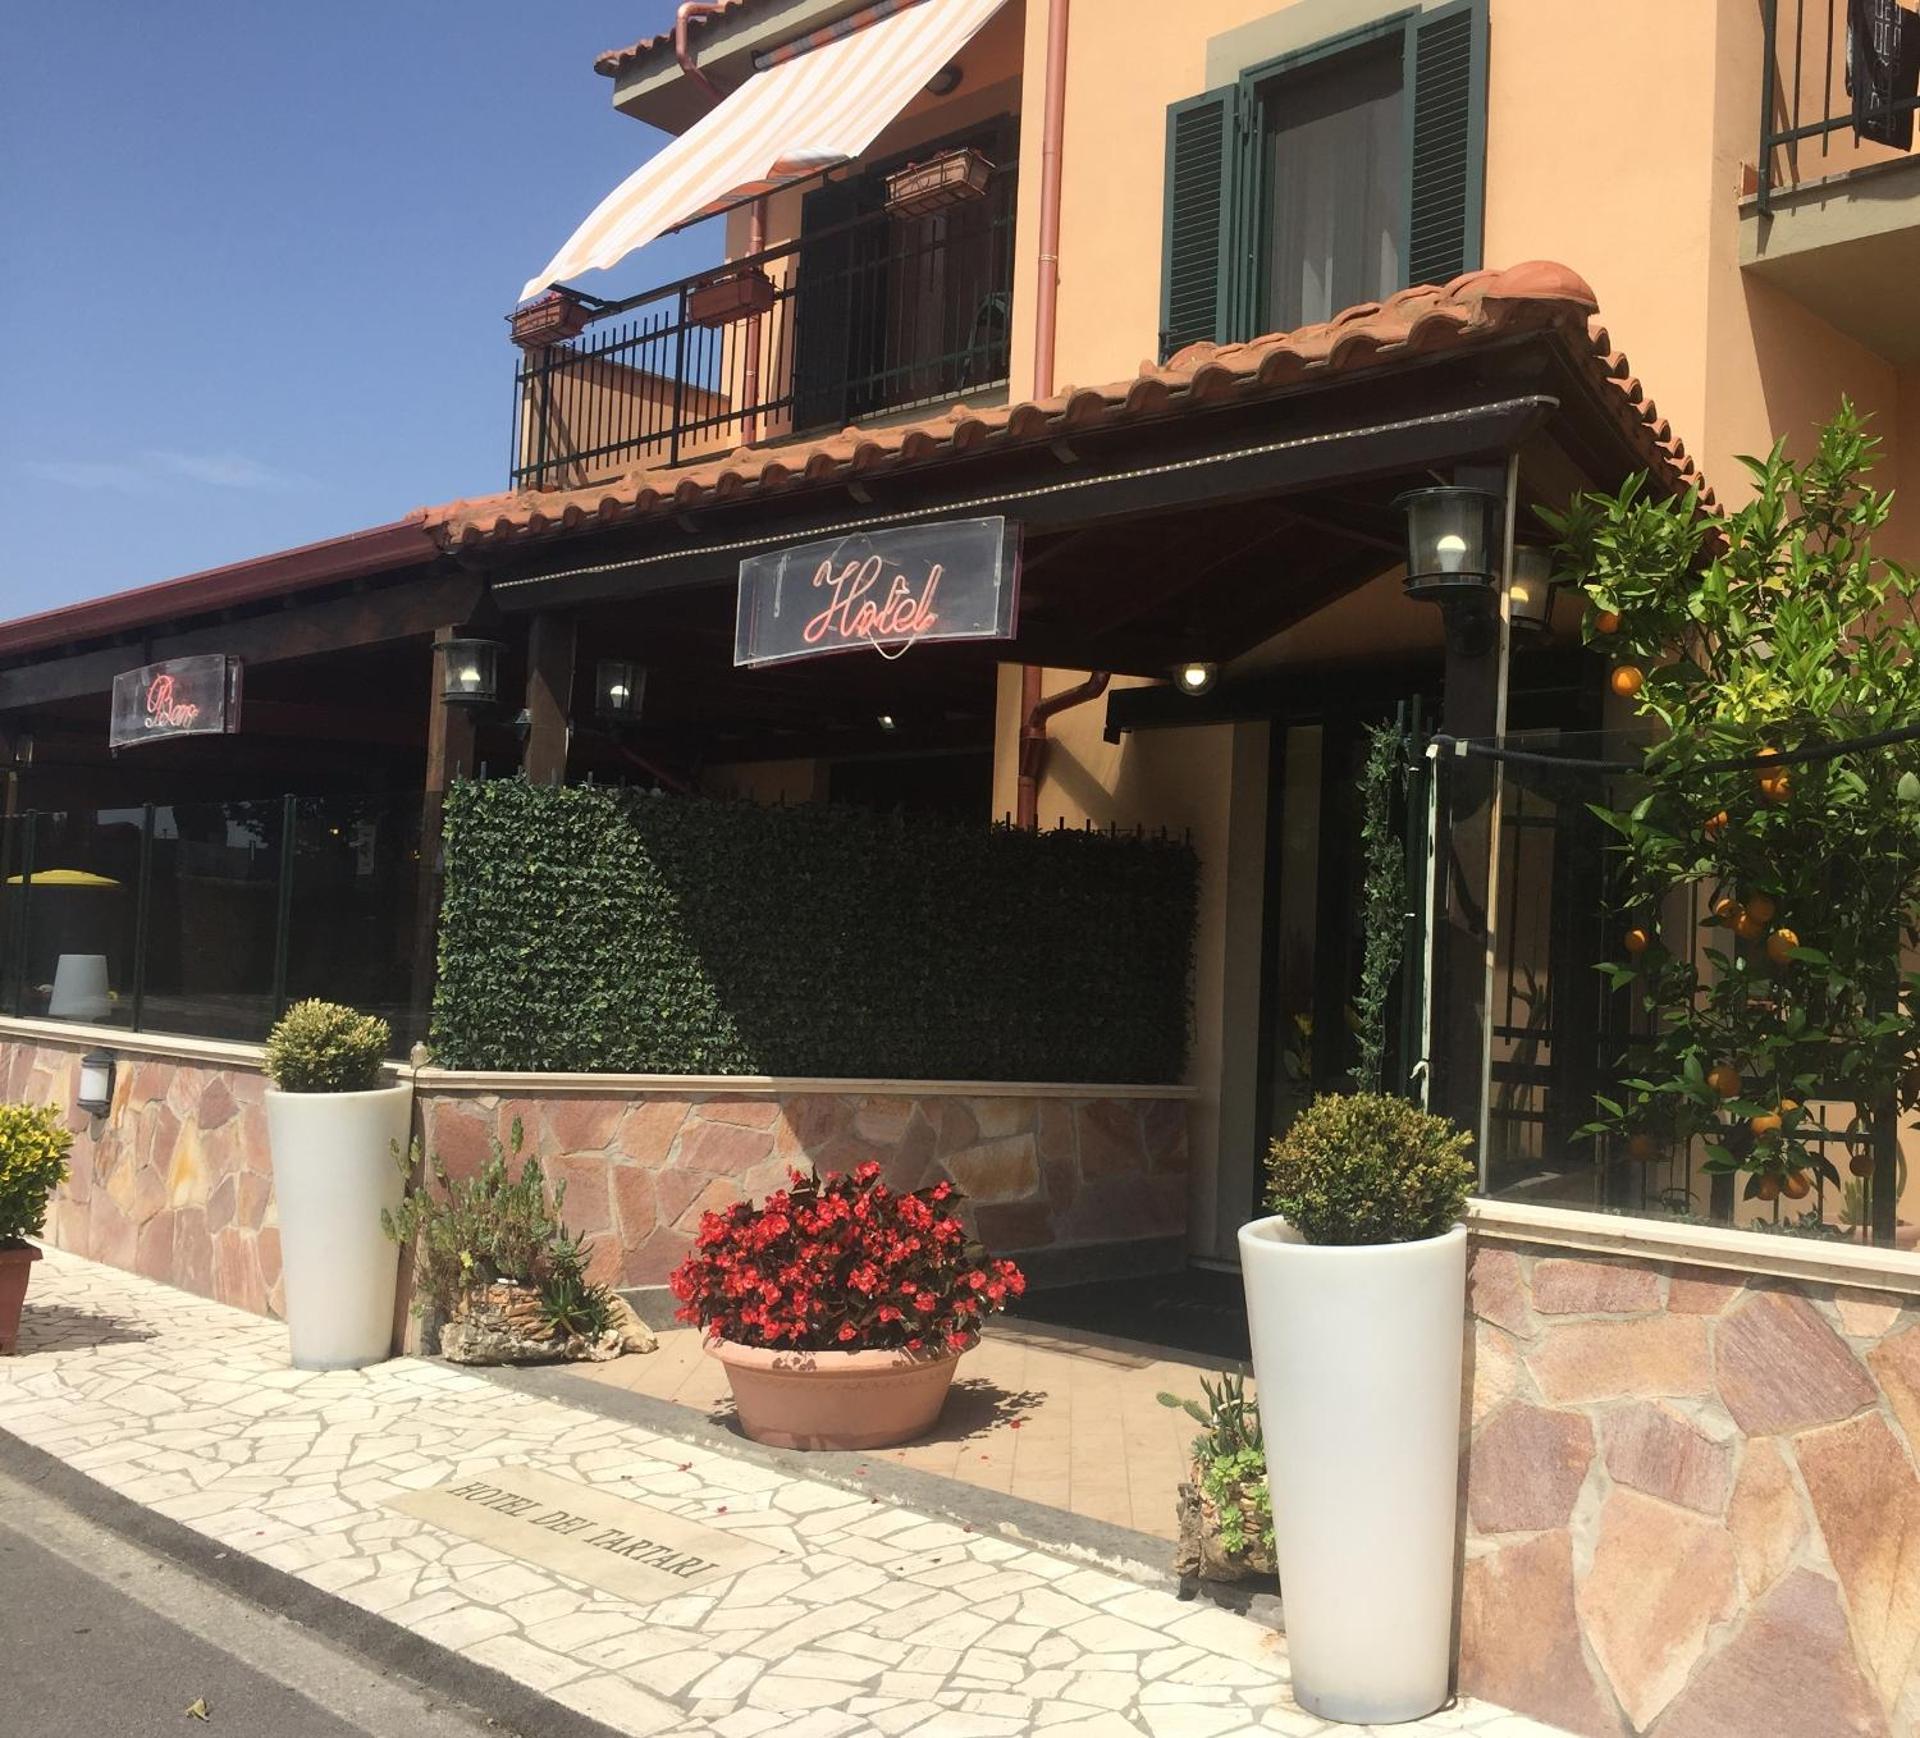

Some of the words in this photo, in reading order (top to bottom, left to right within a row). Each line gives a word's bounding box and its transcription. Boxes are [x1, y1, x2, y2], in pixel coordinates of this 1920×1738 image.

[804, 554, 943, 643] Hotel
[446, 1481, 542, 1518] HOTEL
[528, 1510, 598, 1536] DEI
[582, 1527, 721, 1579] TARTARI
